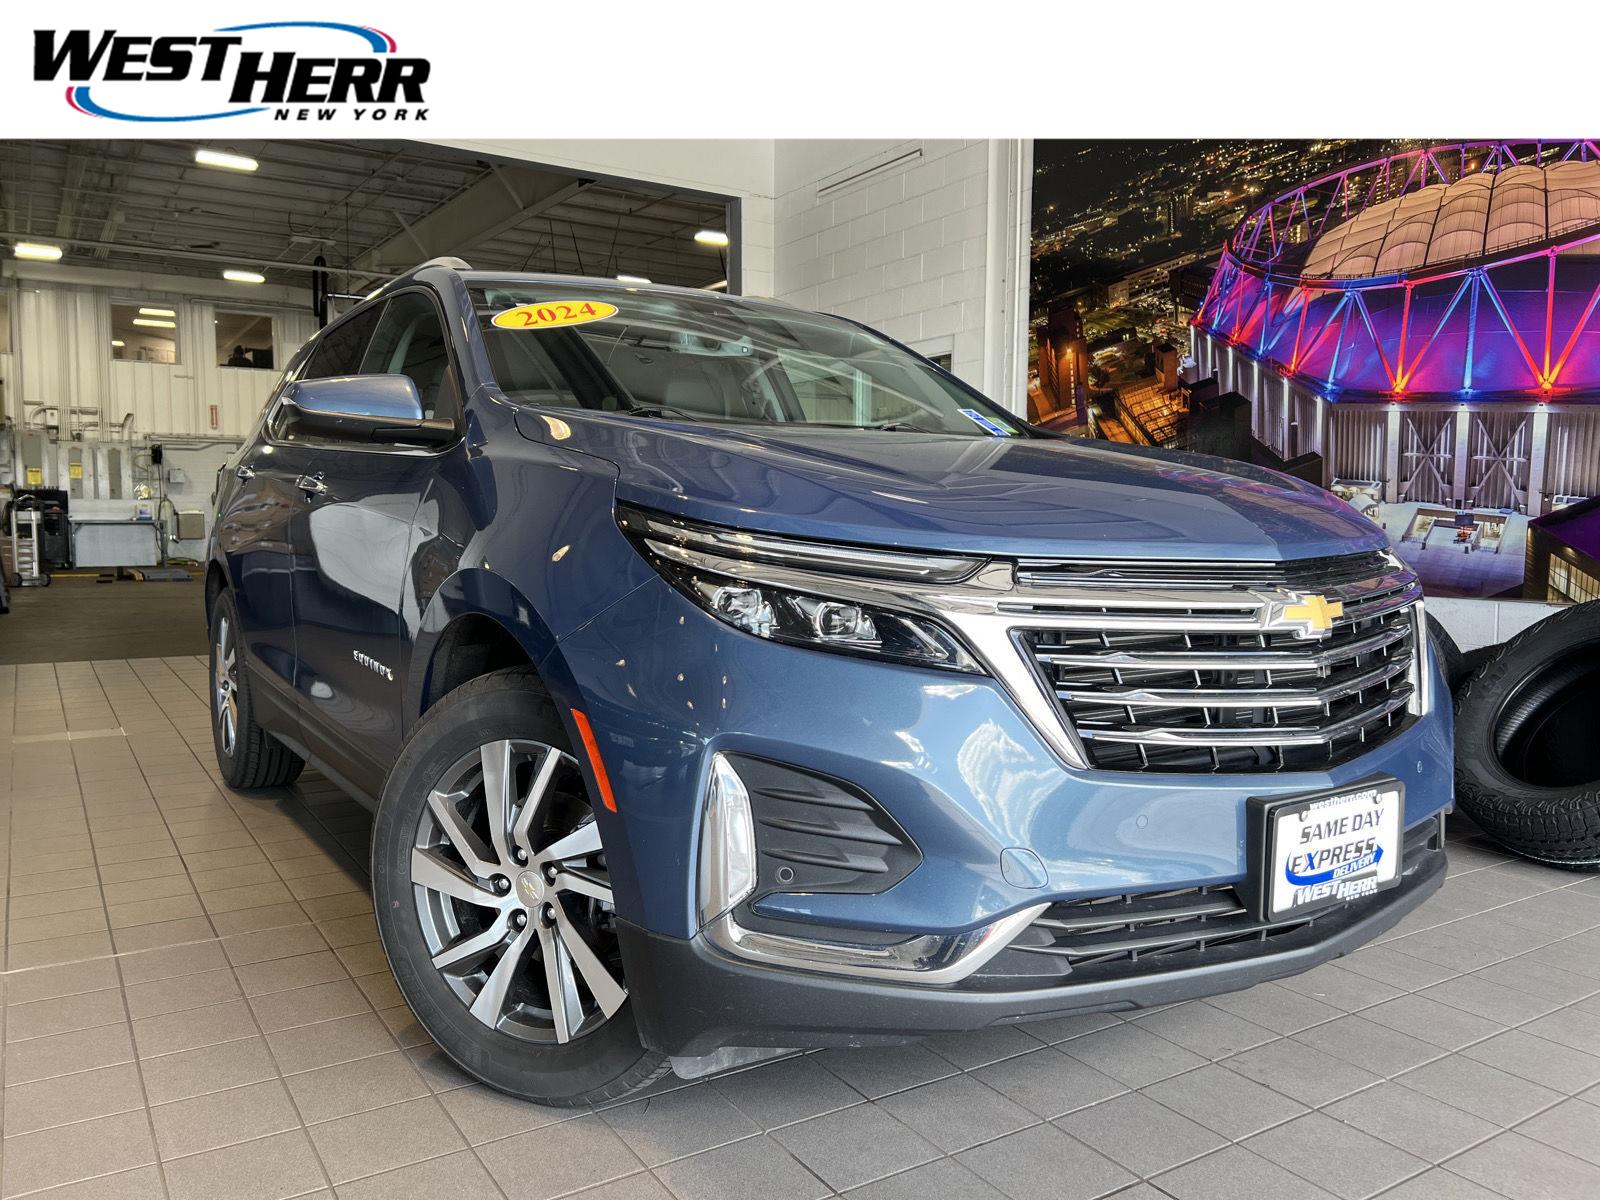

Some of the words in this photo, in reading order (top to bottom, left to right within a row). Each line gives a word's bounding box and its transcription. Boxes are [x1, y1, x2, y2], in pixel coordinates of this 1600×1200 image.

[516, 302, 597, 327] 2024
[1299, 816, 1349, 845] SAME
[1351, 807, 1385, 832] DAY
[1290, 836, 1376, 875] EXPRESS
[1332, 852, 1376, 879] DELIVERY
[1297, 879, 1342, 905] WEST
[1336, 875, 1378, 899] HERR
